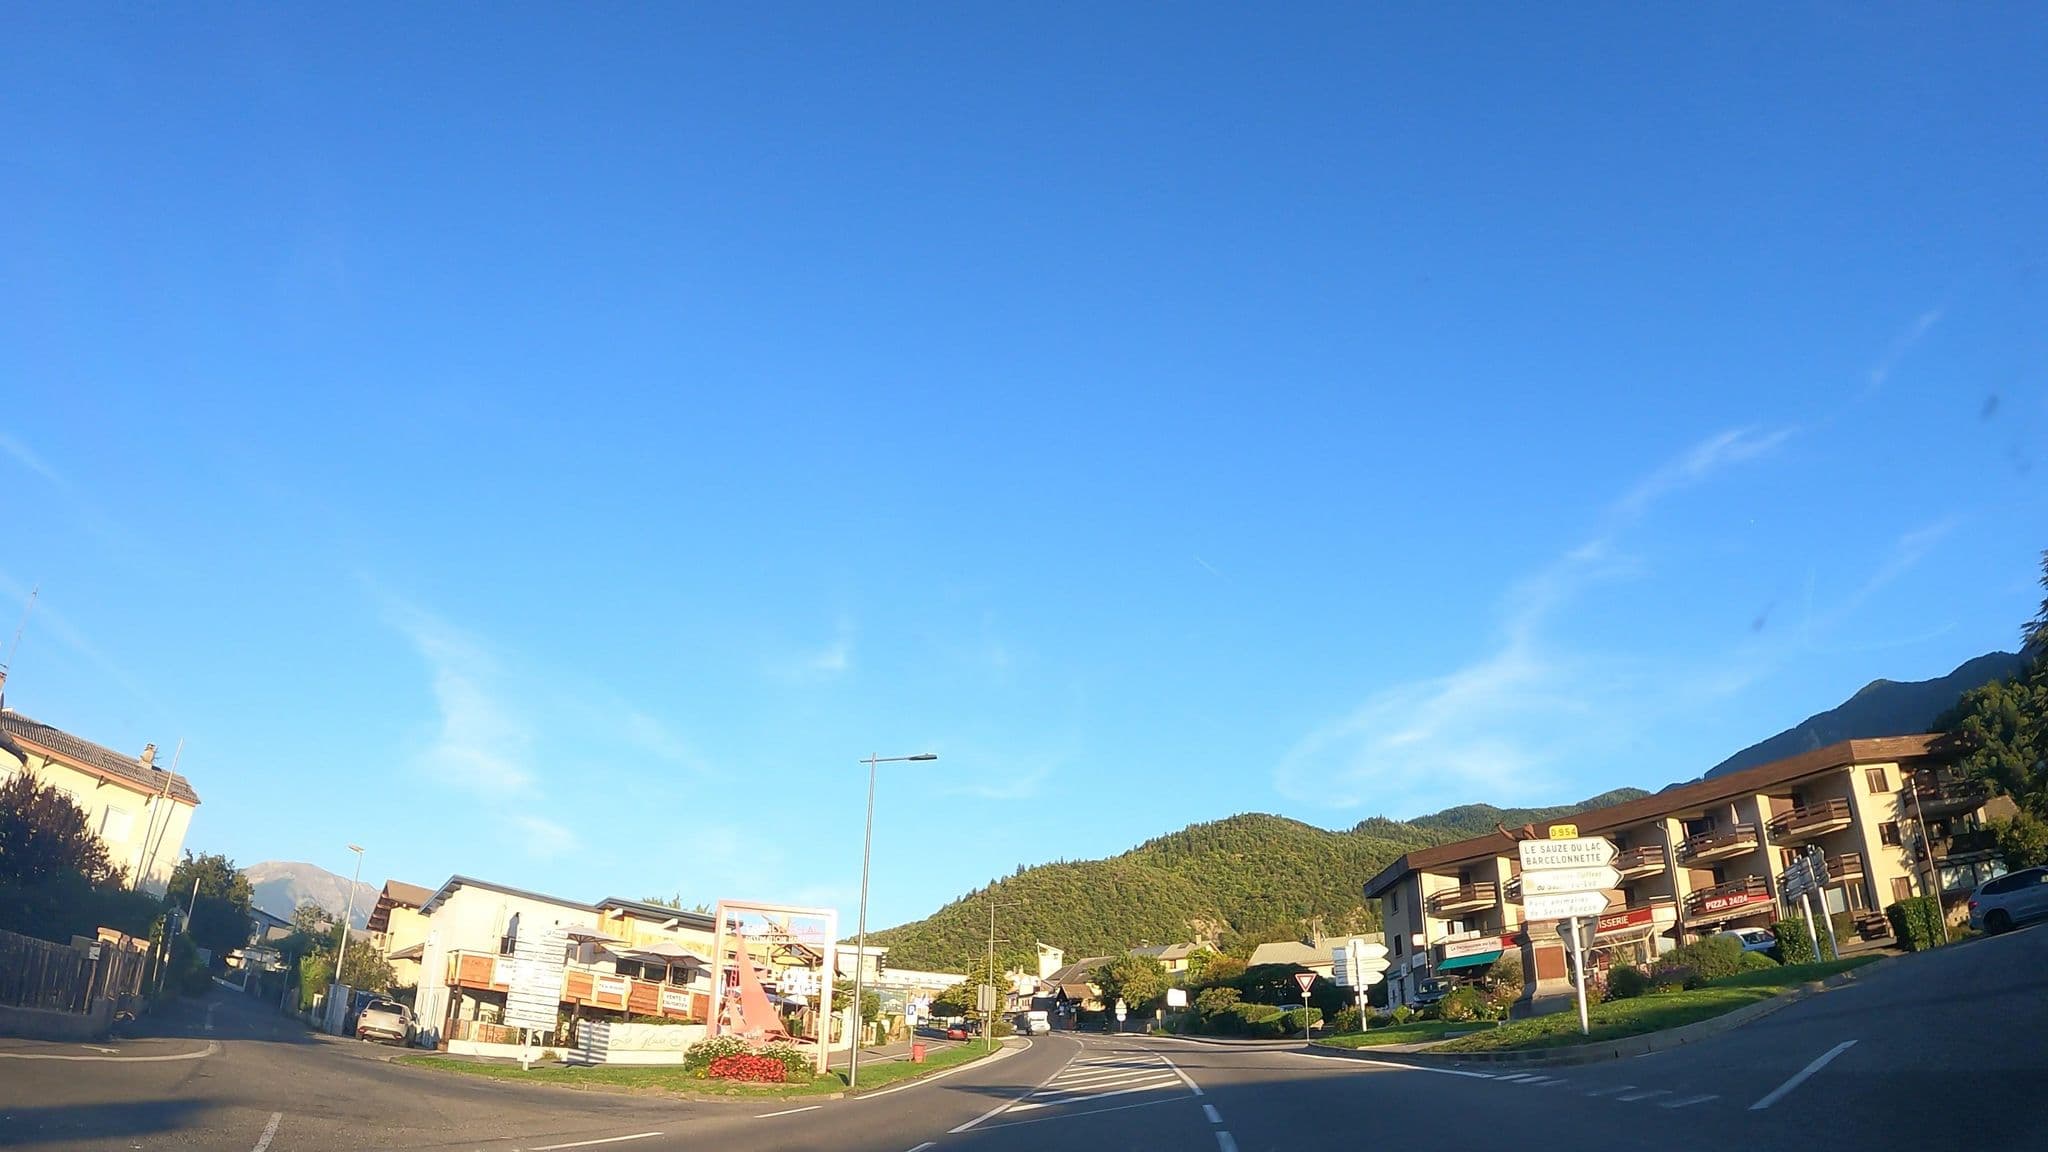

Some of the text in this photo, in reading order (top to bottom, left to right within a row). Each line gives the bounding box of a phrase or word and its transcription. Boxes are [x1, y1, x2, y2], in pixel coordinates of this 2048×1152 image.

[1559, 827, 1577, 836] 954
[1524, 842, 1601, 854] LE SAUZE DU LAC
[1526, 853, 1601, 865] BARCELONNETTE
[1705, 895, 1748, 910] PIZZA 24/24
